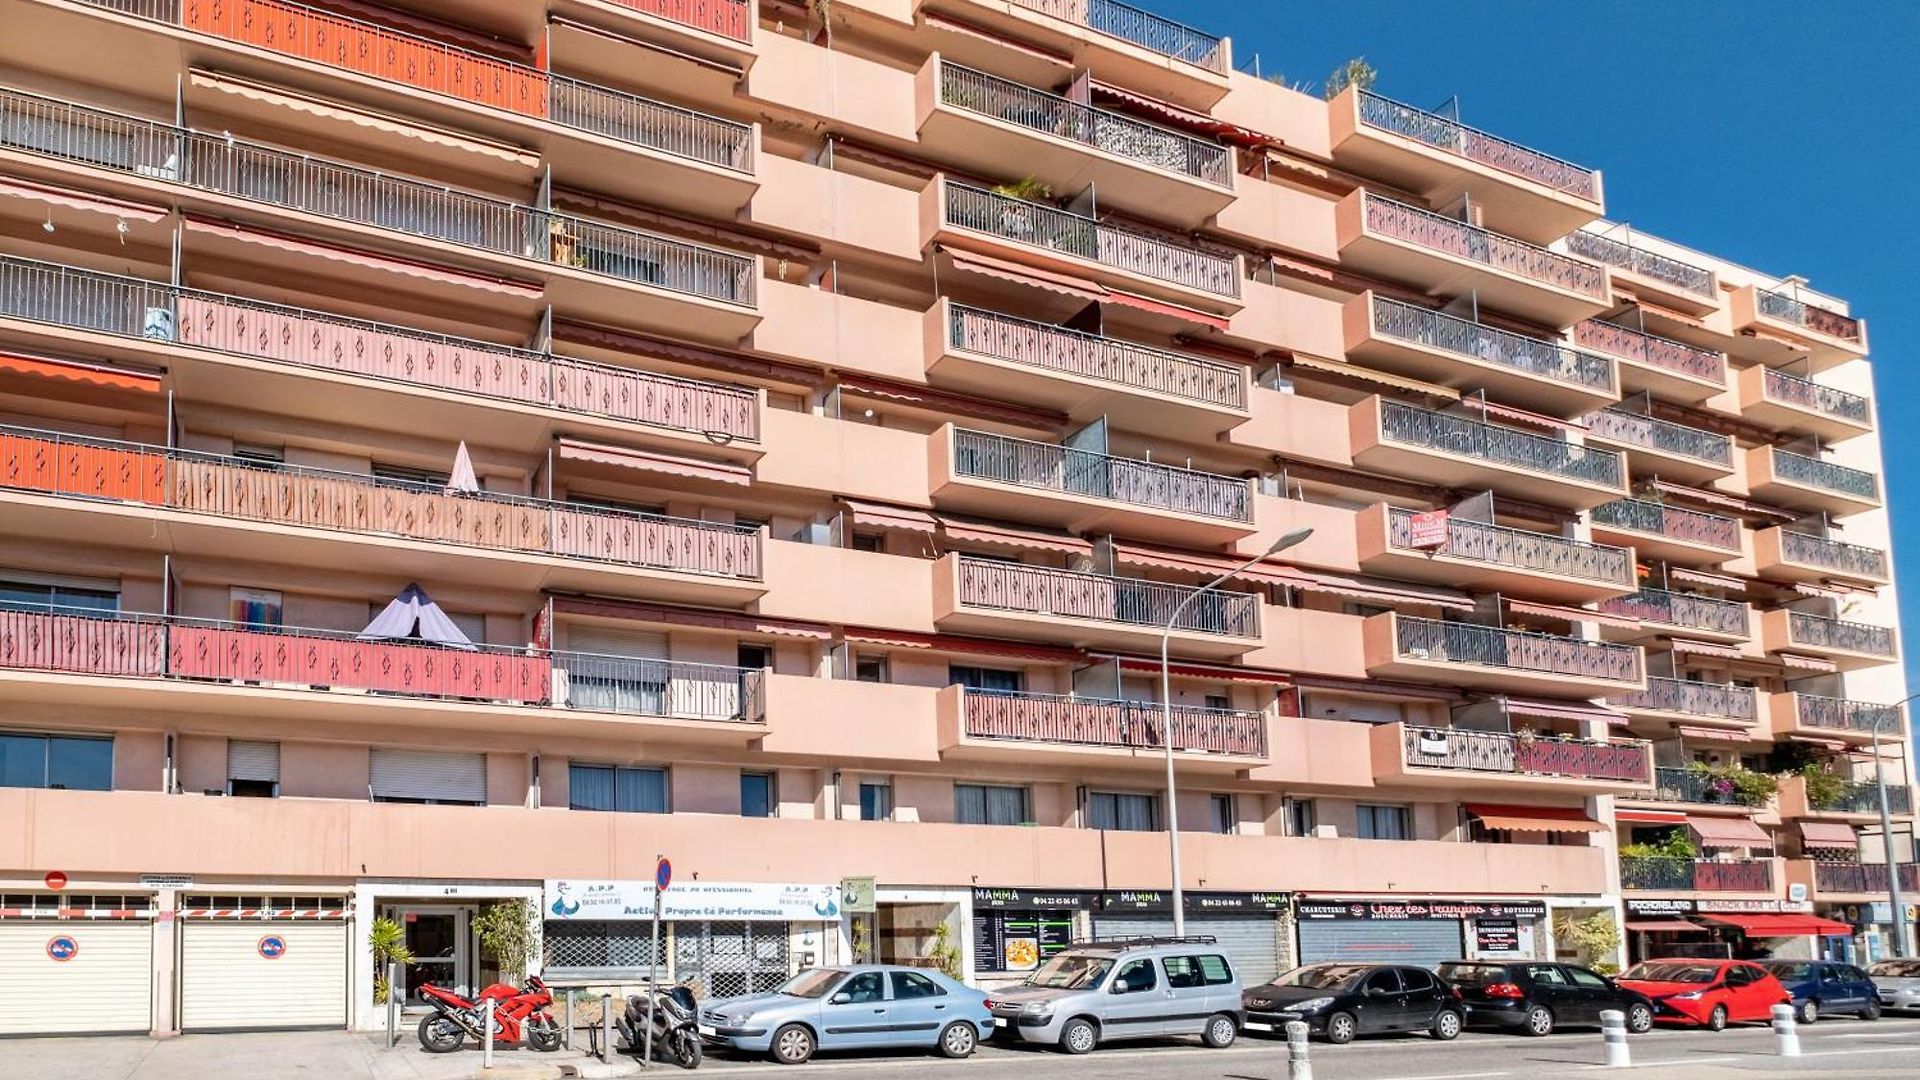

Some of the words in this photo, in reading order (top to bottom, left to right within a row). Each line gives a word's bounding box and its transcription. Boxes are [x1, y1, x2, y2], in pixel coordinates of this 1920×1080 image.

[975, 889, 1019, 901] MAMMA
[1121, 891, 1161, 902] MAMMA
[1252, 893, 1288, 903] MAMMA
[718, 907, 784, 916] Performance
